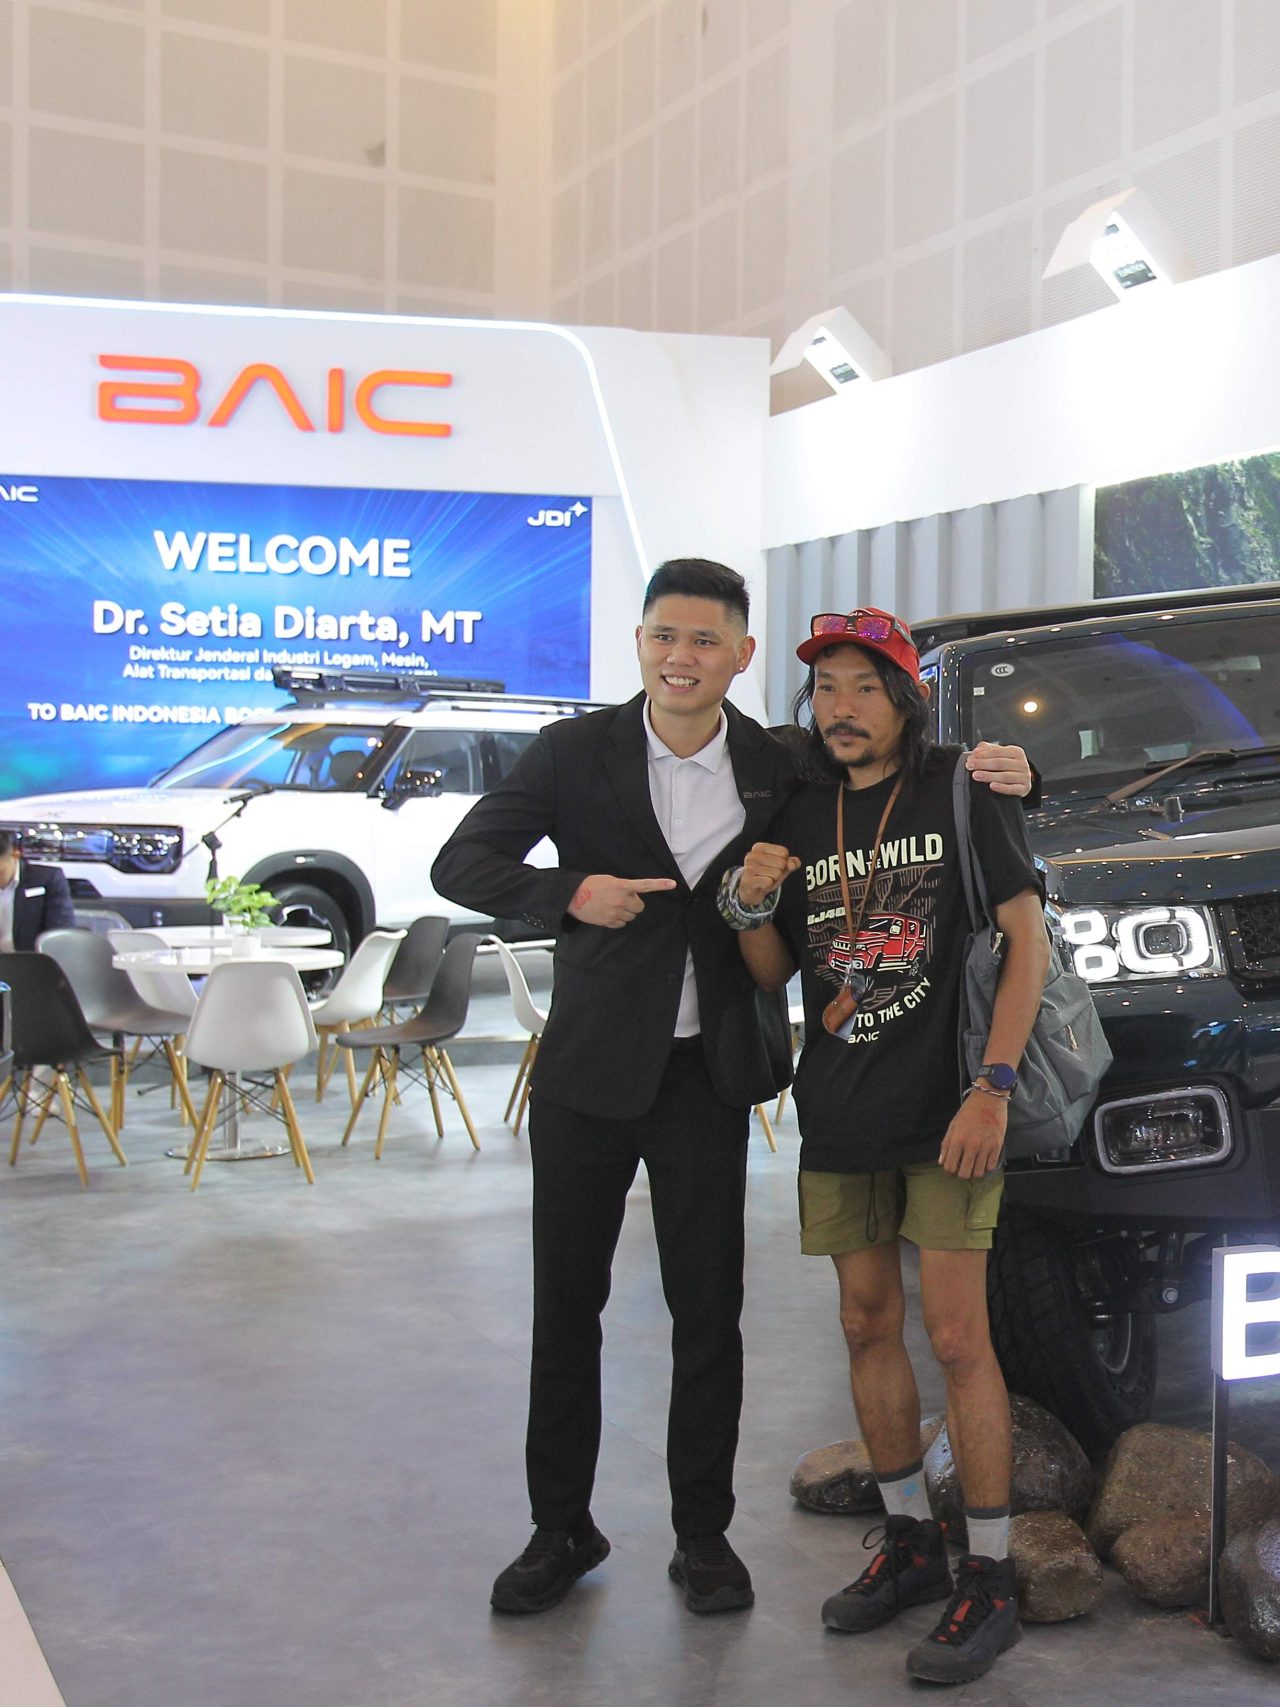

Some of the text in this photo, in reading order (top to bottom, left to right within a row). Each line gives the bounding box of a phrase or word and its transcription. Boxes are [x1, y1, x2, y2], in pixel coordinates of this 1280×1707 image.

[97, 353, 454, 437] BAIC
[154, 530, 412, 578] WELCOME
[93, 600, 482, 648] Dr. Setia Diarta, MT
[122, 664, 155, 679] Alat
[158, 664, 250, 682] Transportasi
[129, 645, 193, 662] Direktur
[262, 650, 320, 666] Industri
[323, 651, 379, 669] Logam,
[381, 654, 429, 670] Mesin,
[28, 703, 57, 721] TO
[61, 704, 108, 723] BAIC
[112, 704, 222, 724] INDONESIA
[805, 849, 866, 891] BORN
[880, 833, 943, 869] WILD
[856, 976, 931, 1028] TO THE CITY
[847, 1030, 880, 1044] BAIC
